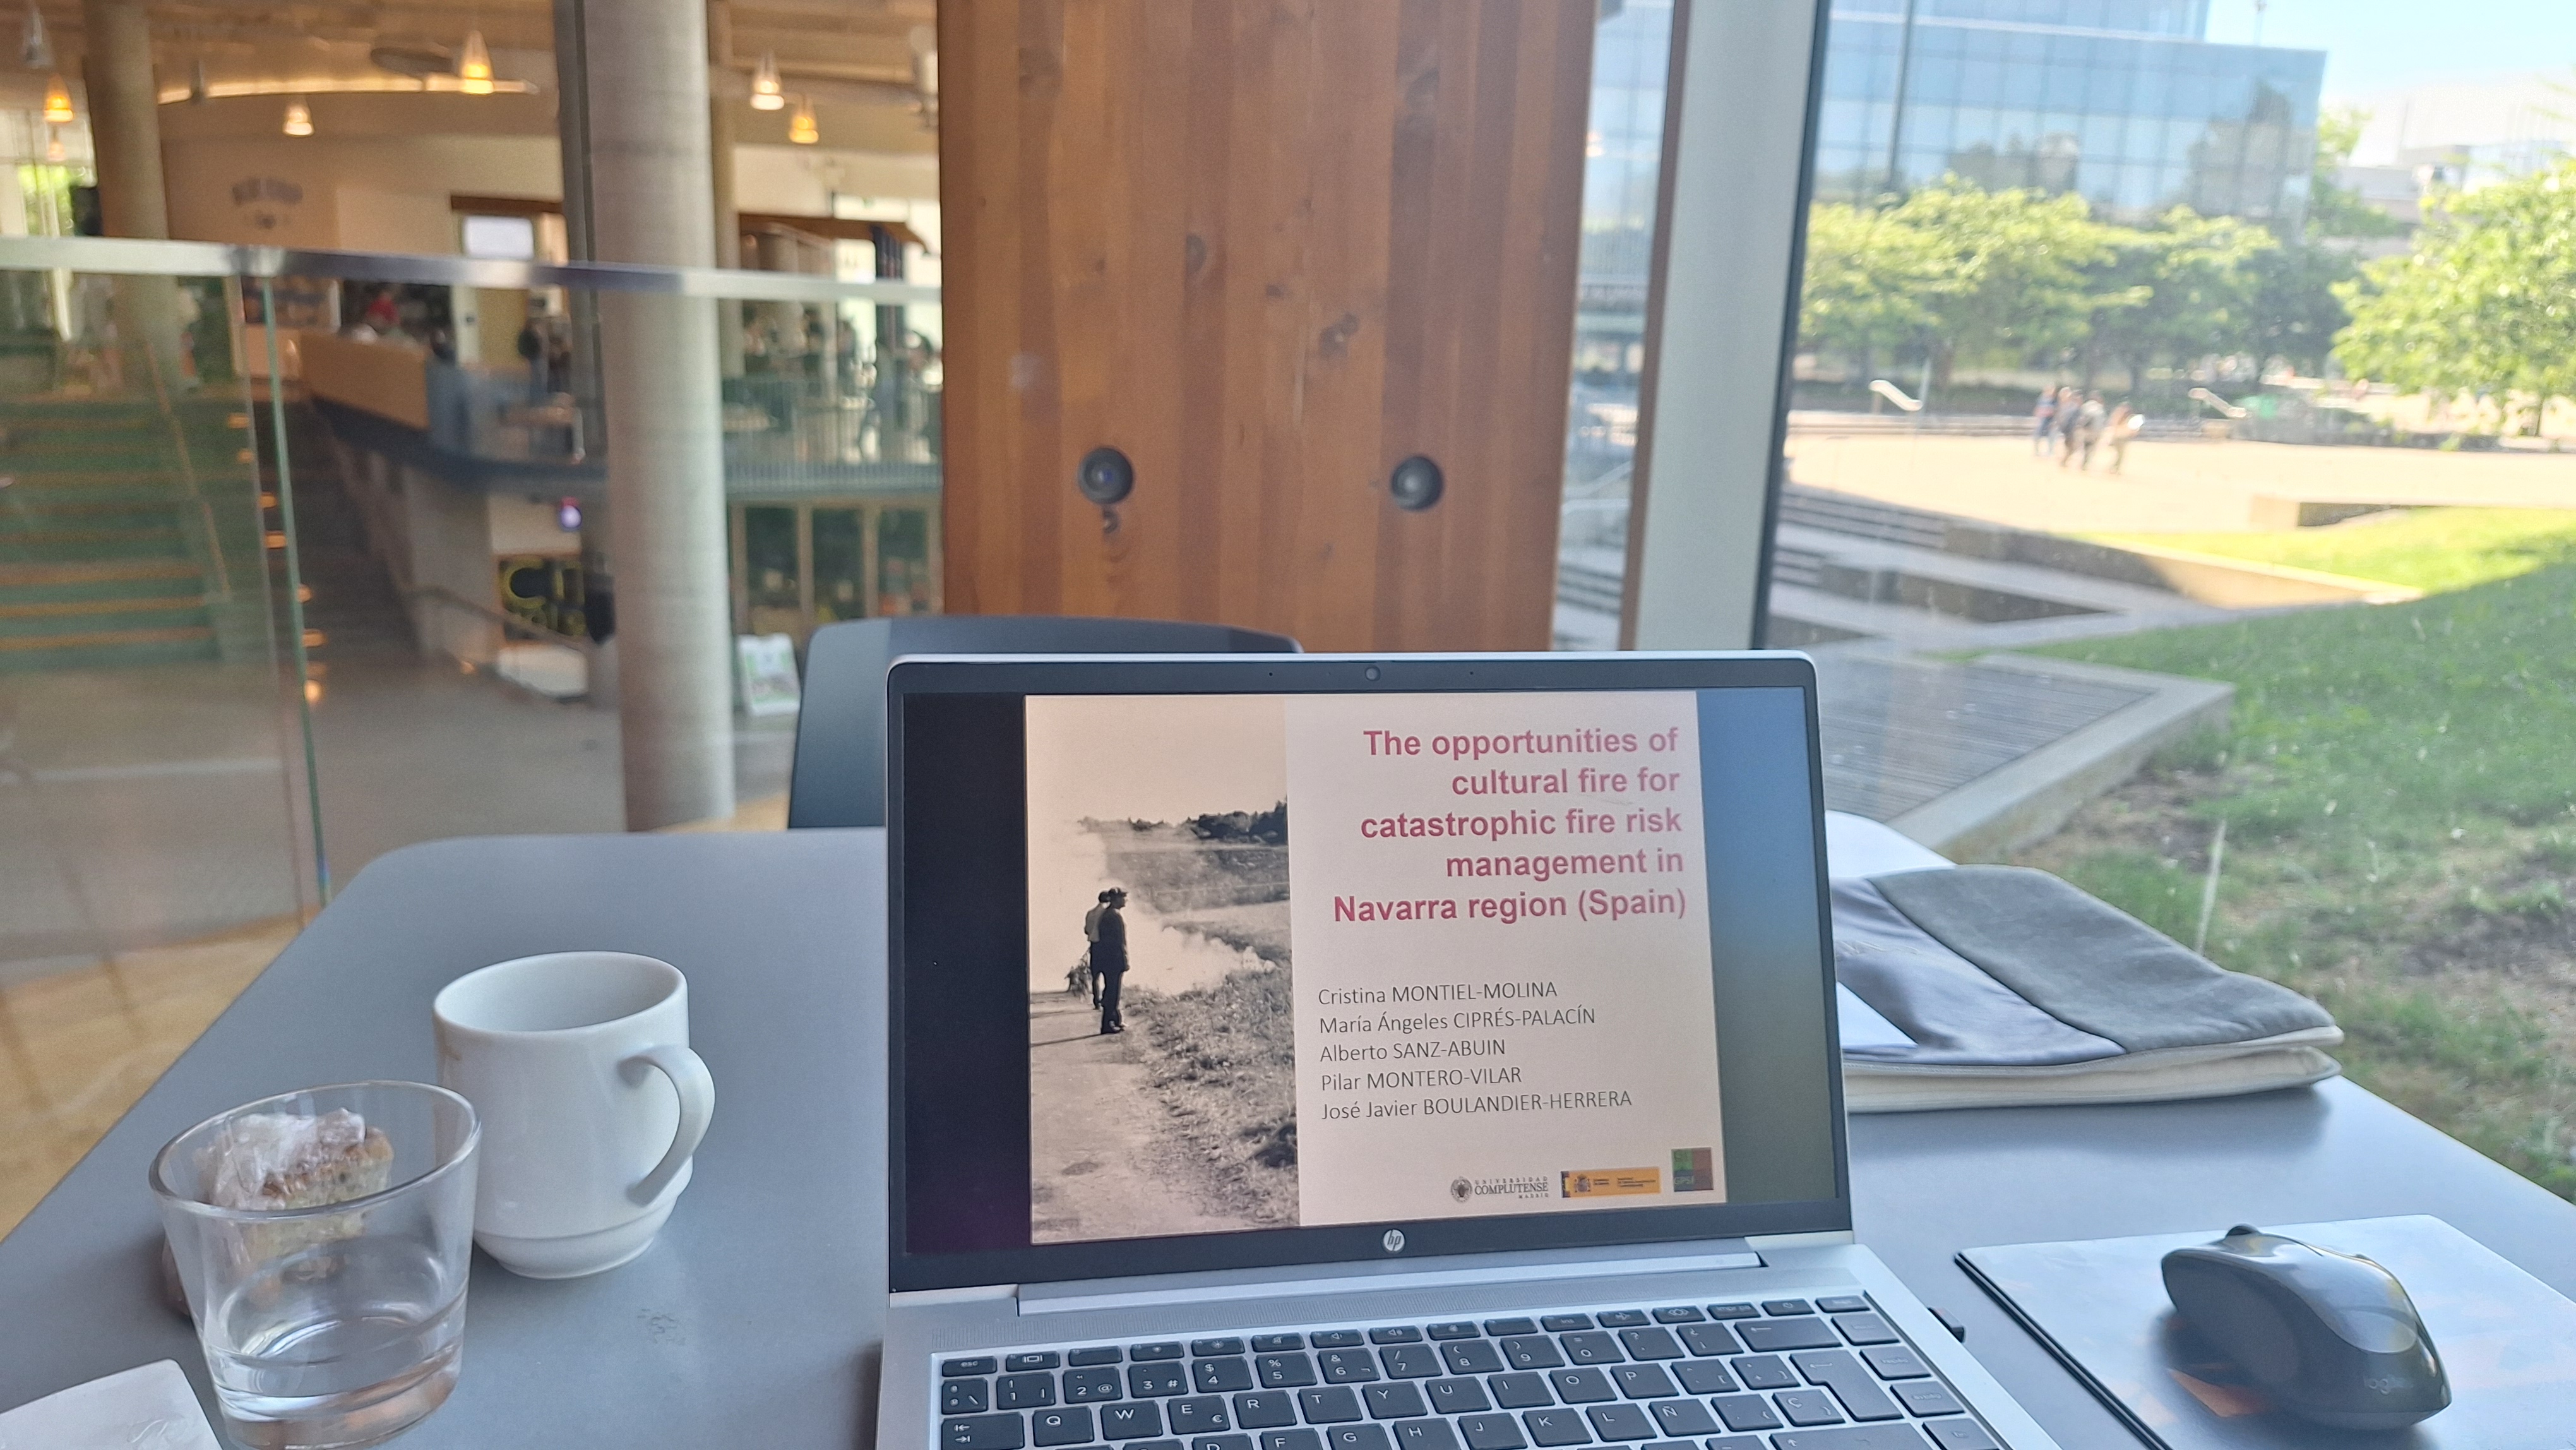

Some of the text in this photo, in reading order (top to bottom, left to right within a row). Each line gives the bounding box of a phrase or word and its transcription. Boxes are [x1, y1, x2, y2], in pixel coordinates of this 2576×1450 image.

[1364, 727, 1678, 761] The opportunities of
[1452, 767, 1680, 795] cultural fire for
[1361, 808, 1682, 841] catastrophic fire risk
[1446, 848, 1683, 882] management in
[1334, 888, 1686, 925] Navarra region (Spain)
[1318, 981, 1558, 1005] Cristina MONTIEL-MOLINA
[1320, 1005, 1595, 1034] María Ángeles CIPRÉS-PALACÍN
[1320, 1040, 1506, 1062] Alberto SANZ-ABUIN
[1321, 1067, 1522, 1091] Pilar MONTERO-VILAR
[1322, 1091, 1633, 1120] José Javier BOULANDIER-HERRERA
[1475, 1176, 1548, 1185] UNIVERSIDAD
[1474, 1182, 1549, 1195] COMPLUTENSE
[1386, 1229, 1403, 1251] hp
[1268, 1358, 1282, 1367] %
[1330, 1354, 1342, 1363] &
[1204, 1363, 1215, 1374] $
[1335, 1367, 1347, 1375] 6
[1208, 1375, 1219, 1384] 4
[1272, 1371, 1284, 1380] 5
[1625, 1370, 1638, 1381] P
[1097, 1384, 1113, 1394] @
[1143, 1380, 1154, 1389] 3
[1167, 1379, 1179, 1388] #
[1439, 1384, 1453, 1394] U
[1076, 1386, 1088, 1396] 2
[1376, 1389, 1389, 1400] Y
[1246, 1398, 1261, 1410] R
[1310, 1394, 1323, 1405] T
[1114, 1408, 1135, 1421] W
[1181, 1404, 1194, 1415] E
[1046, 1415, 1062, 1427] Q
[1537, 1416, 1553, 1427] K
[1601, 1411, 1616, 1422] L
[1407, 1426, 1423, 1437] H
[1475, 1421, 1484, 1432] J
[1274, 1437, 1287, 1448] F
[1342, 1432, 1357, 1442] G
